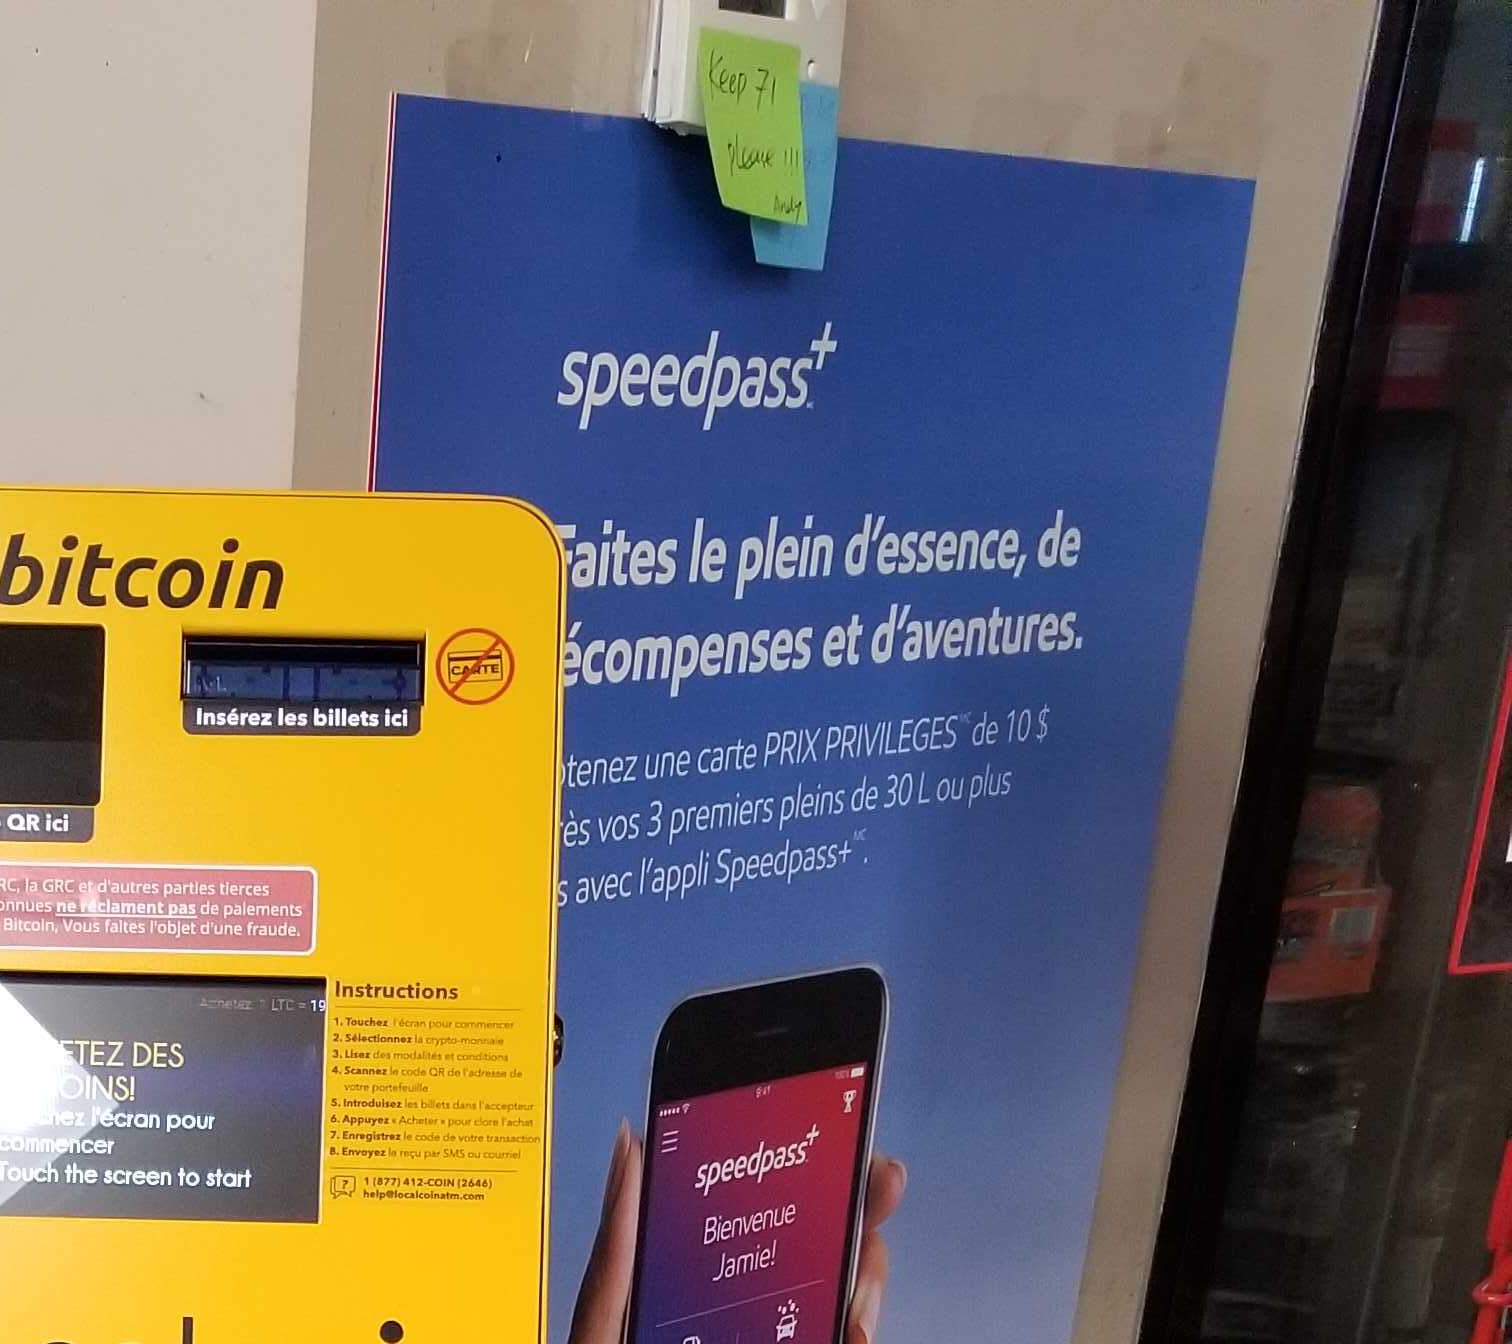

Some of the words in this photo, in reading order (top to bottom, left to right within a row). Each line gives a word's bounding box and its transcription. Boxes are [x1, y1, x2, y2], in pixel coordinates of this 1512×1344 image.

[709, 49, 747, 104] Keep
[689, 518, 727, 583] le
[734, 515, 834, 600] plein
[844, 512, 1028, 579] d'essence,
[1036, 510, 1082, 569] de
[563, 621, 813, 698] écompenses
[822, 614, 862, 666] et
[870, 604, 1083, 663] d'aventures.
[451, 663, 500, 676] CARTE
[196, 707, 273, 727] Insérez
[278, 708, 308, 727] les
[313, 708, 379, 728] billets
[384, 708, 409, 728] ici
[644, 747, 691, 780] une
[696, 737, 758, 775] carte
[764, 728, 819, 769] PRIX
[826, 715, 958, 760] PRIVILEGES
[972, 711, 998, 746] de
[1006, 709, 1031, 744] 10
[598, 808, 639, 843] vos
[648, 801, 664, 837] 3
[669, 792, 774, 846] premiers
[779, 781, 846, 829] pleins
[850, 776, 878, 812] de
[883, 774, 914, 809] 30
[937, 774, 964, 803] ou
[969, 763, 1012, 808] plus
[7, 813, 40, 832] QR
[46, 813, 69, 832] ici
[576, 869, 632, 903] avec
[639, 850, 709, 903] l'appli
[42, 879, 74, 893] GRC
[98, 879, 159, 894] d'autres
[163, 882, 216, 897] parties
[219, 881, 270, 896] tierces
[168, 904, 196, 917] pas
[200, 901, 218, 914] de
[224, 903, 303, 917] paiements
[62, 919, 100, 933] Vous
[105, 920, 146, 934] faites
[150, 921, 197, 938] l'objet
[200, 922, 243, 936] d'une
[335, 980, 458, 1000] Instructions
[345, 1017, 388, 1027] Touchez
[345, 1033, 412, 1044] Sélectionnez
[132, 1042, 185, 1069] DES
[343, 1098, 402, 1109] Introduisez
[91, 1108, 160, 1130] l'écran
[167, 1113, 215, 1133] pour
[342, 1114, 389, 1126] Appuyez
[342, 1131, 401, 1142] Enregistrez
[341, 1147, 386, 1158] Envoyez
[65, 1163, 98, 1185] the
[103, 1168, 172, 1187] screen
[177, 1167, 199, 1188] to
[206, 1168, 252, 1189] start
[373, 1177, 401, 1188] (877)
[403, 1177, 455, 1187] 412-COIN
[457, 1178, 493, 1189] (2646)
[363, 1190, 485, 1201] help@localcoinatm.com
[703, 1201, 797, 1245] Bienvenue
[712, 1240, 777, 1282] Jamie!
